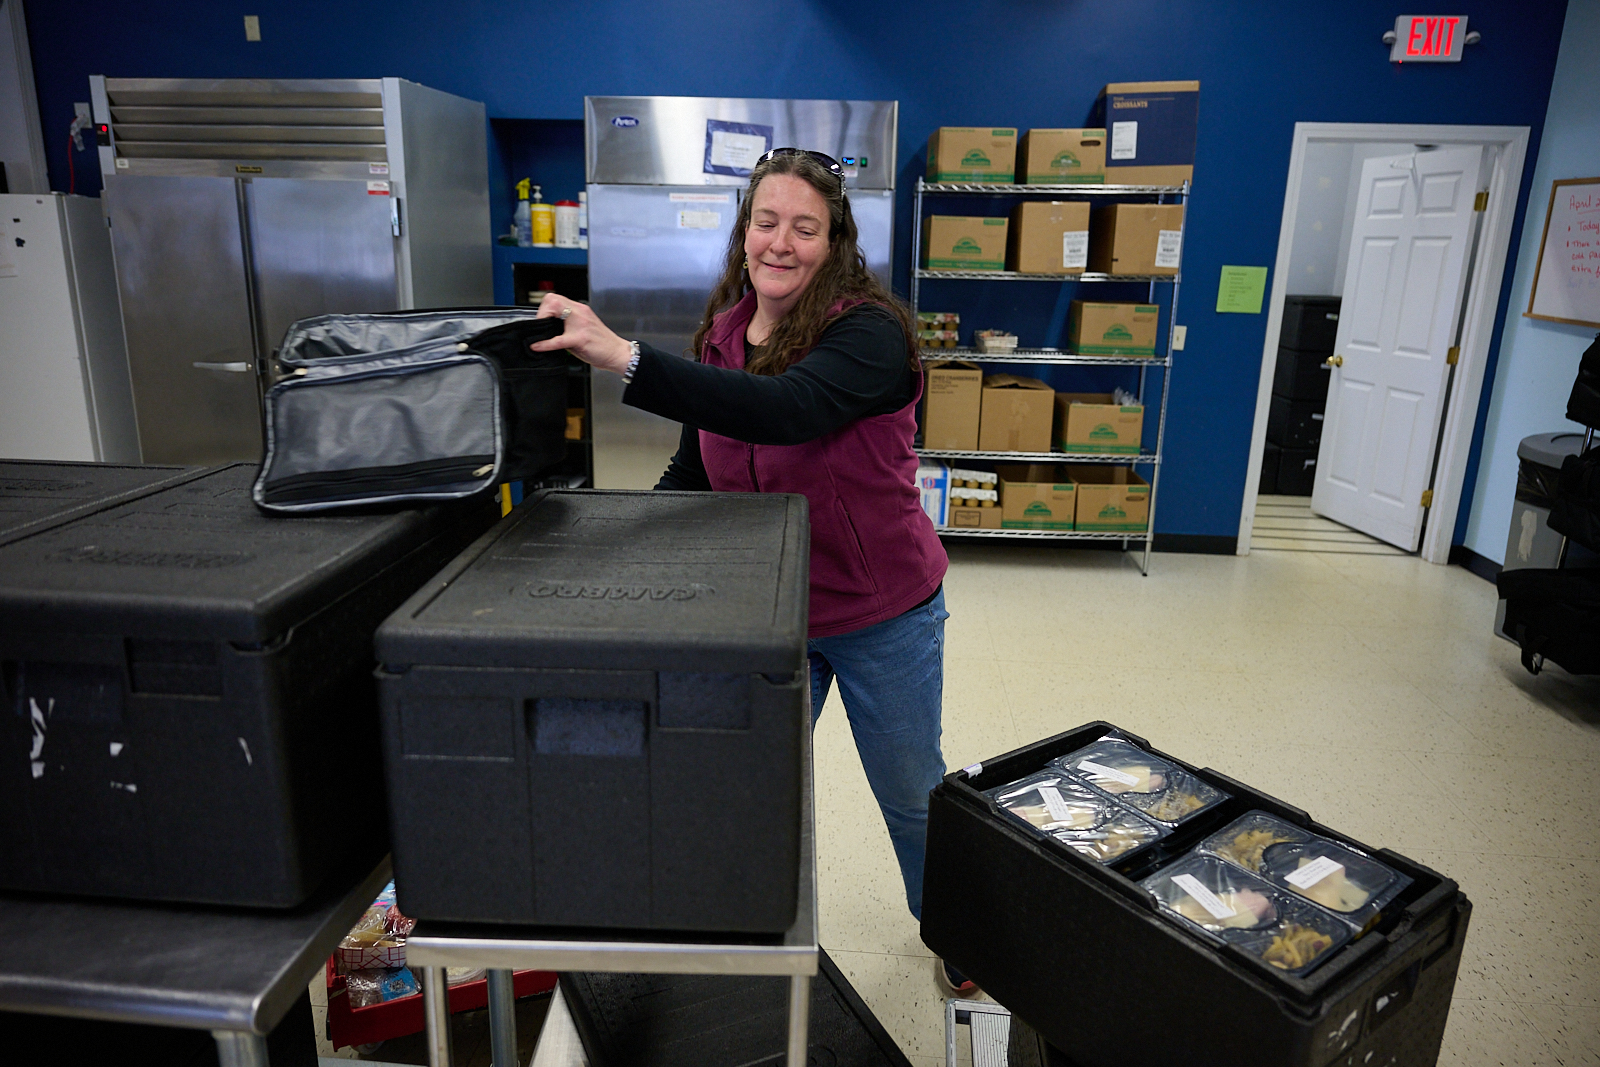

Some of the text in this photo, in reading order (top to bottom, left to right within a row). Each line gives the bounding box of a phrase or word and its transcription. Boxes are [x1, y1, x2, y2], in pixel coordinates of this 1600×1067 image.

[1406, 17, 1459, 56] EXIT
[1569, 194, 1592, 211] April
[1578, 221, 1600, 235] Today
[1571, 263, 1592, 274] extra
